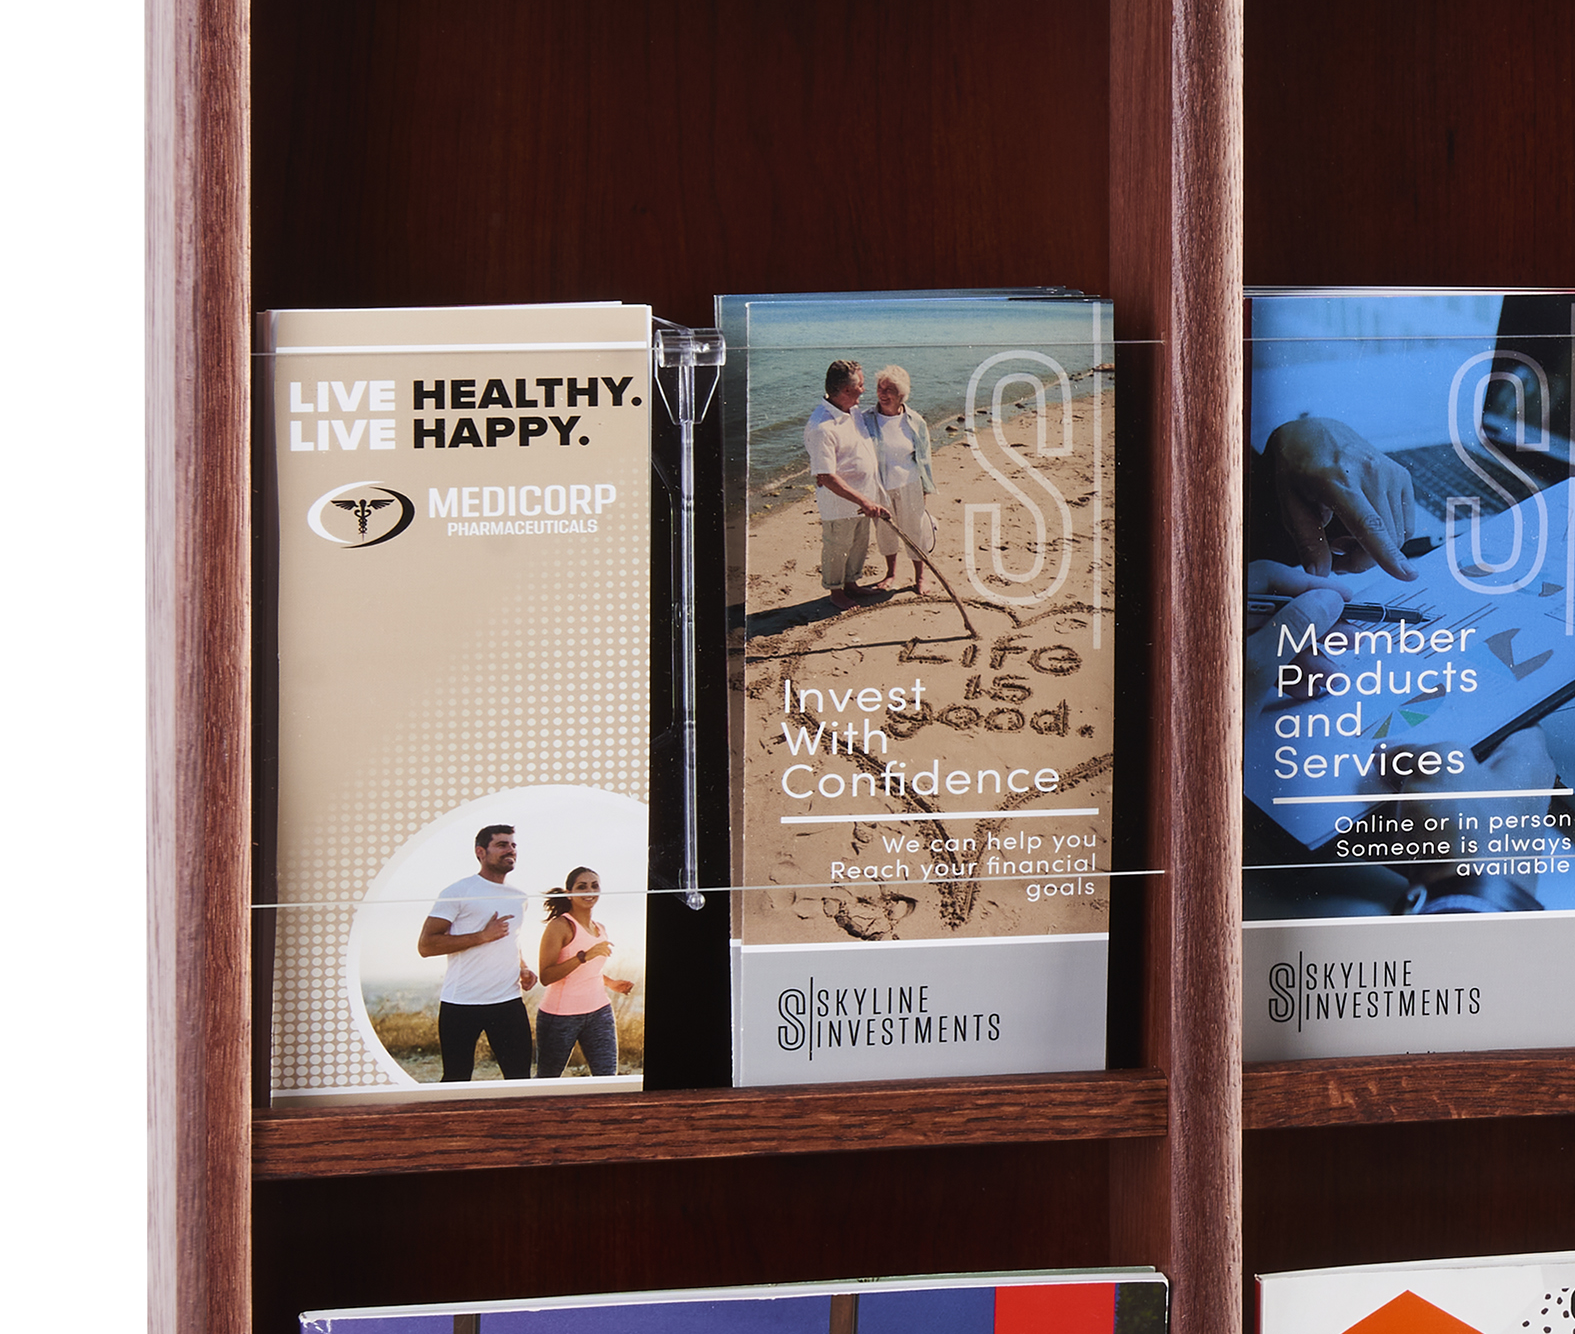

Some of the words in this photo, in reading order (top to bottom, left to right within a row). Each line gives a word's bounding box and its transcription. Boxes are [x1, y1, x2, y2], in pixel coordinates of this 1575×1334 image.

[290, 381, 395, 412] LIVE
[413, 376, 642, 410] HEALTHY.
[290, 419, 396, 451] LIVE
[413, 416, 590, 449] HAPPY.
[429, 484, 616, 518] MEDICORP
[447, 519, 598, 536] PHARMACEUTICALS
[1277, 619, 1476, 657] Member
[784, 679, 925, 713] Invest
[1278, 660, 1478, 698] Products
[781, 719, 887, 755] With
[1275, 702, 1362, 738] and
[781, 759, 1059, 799] Confidence
[1274, 744, 1465, 779] Services
[1335, 814, 1413, 834] Online
[1424, 817, 1449, 830] or
[1459, 814, 1478, 829] in
[1489, 812, 1571, 833] person
[882, 835, 919, 854] We
[931, 835, 976, 852] can
[987, 832, 1042, 852] help
[1053, 834, 1096, 852] you
[1027, 878, 1095, 902] goals
[817, 985, 929, 1017] SKYLINE
[817, 1013, 1000, 1048] INVESTMENTS
